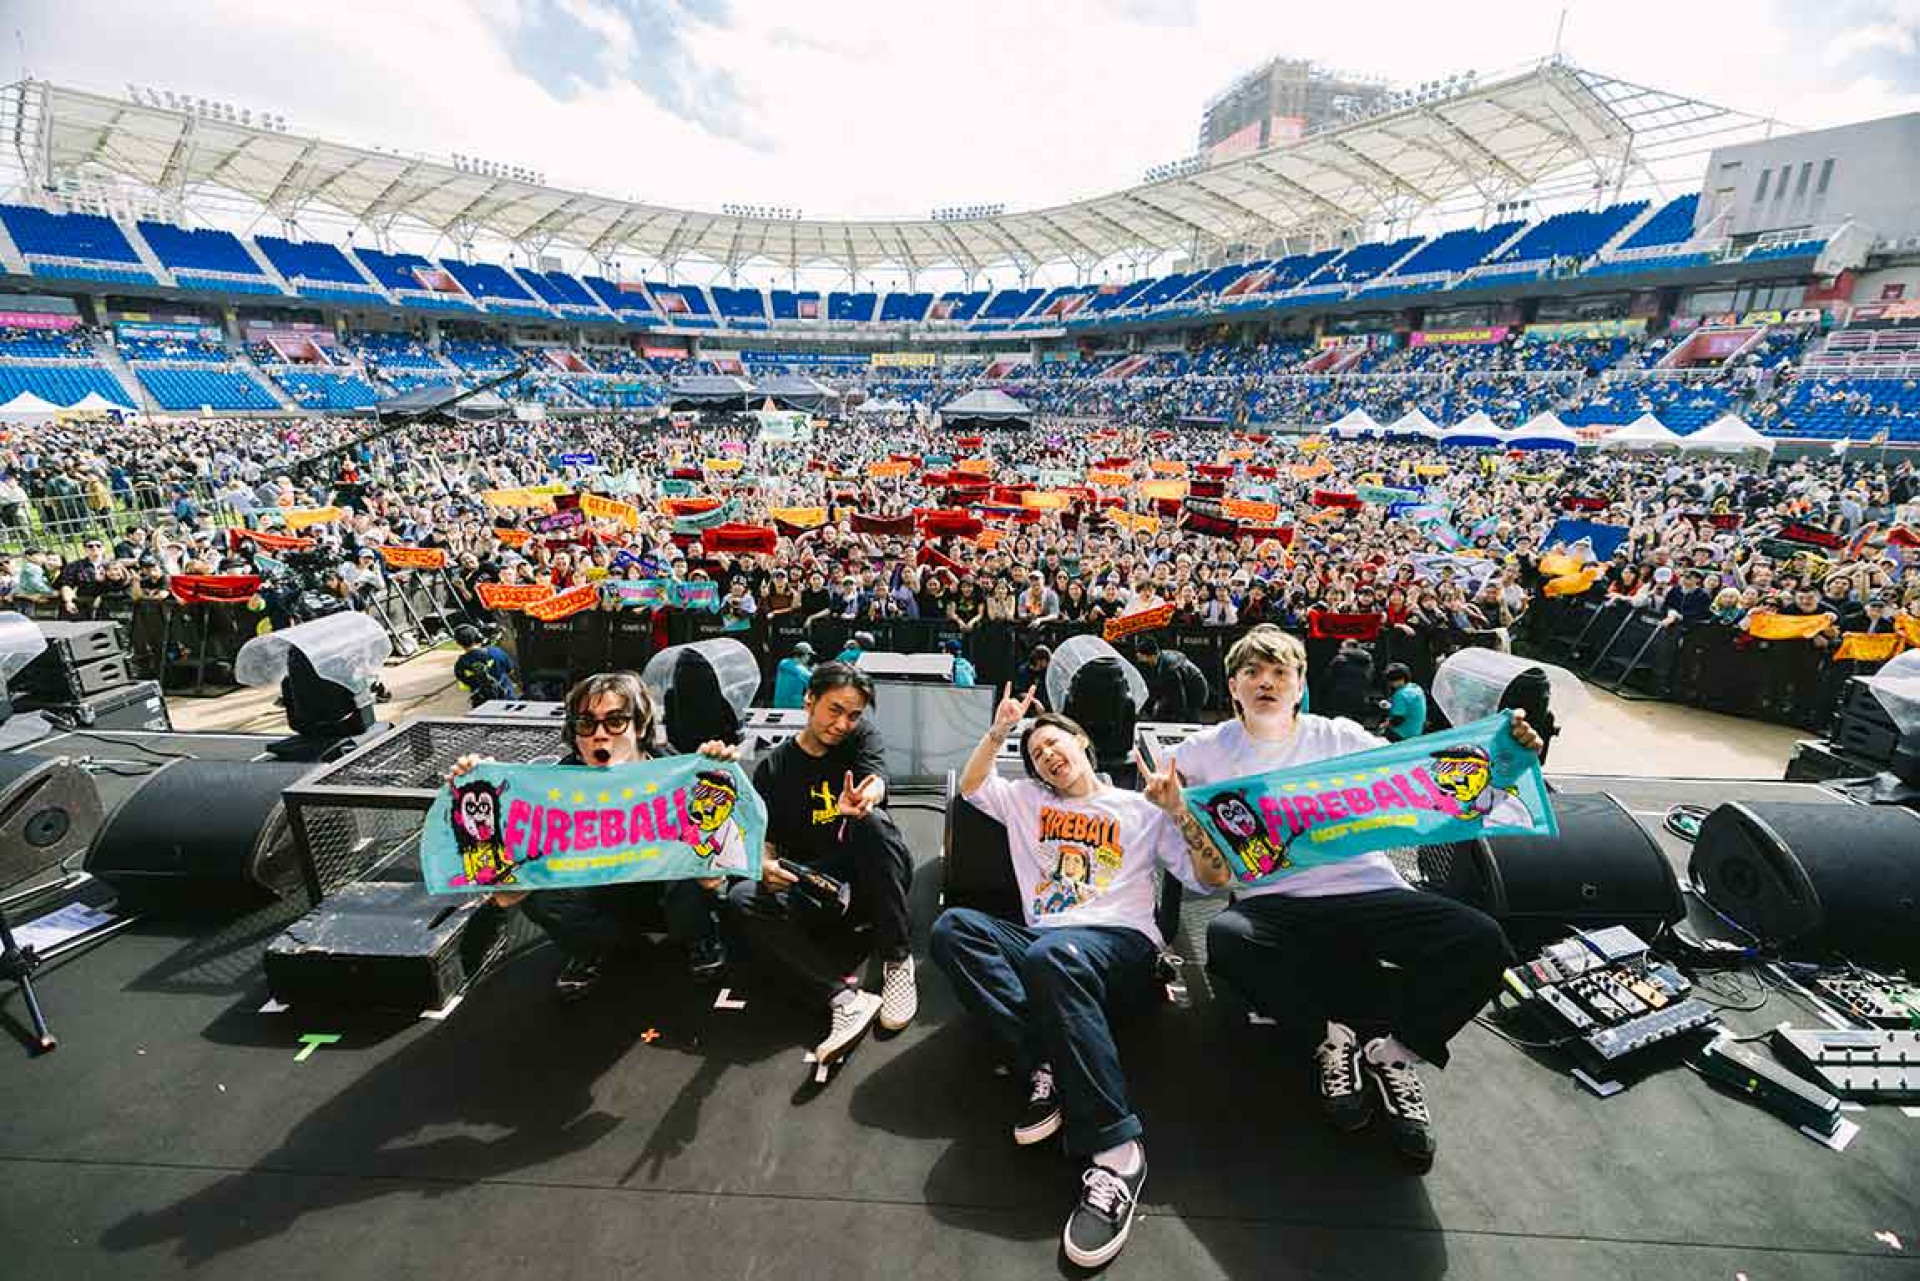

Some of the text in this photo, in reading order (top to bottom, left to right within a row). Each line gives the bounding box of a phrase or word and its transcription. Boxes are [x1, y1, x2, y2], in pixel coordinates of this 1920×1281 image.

[505, 788, 698, 860] FIREBALL
[1040, 811, 1122, 853] FIREBALL
[1258, 767, 1458, 845] FIREBALL
